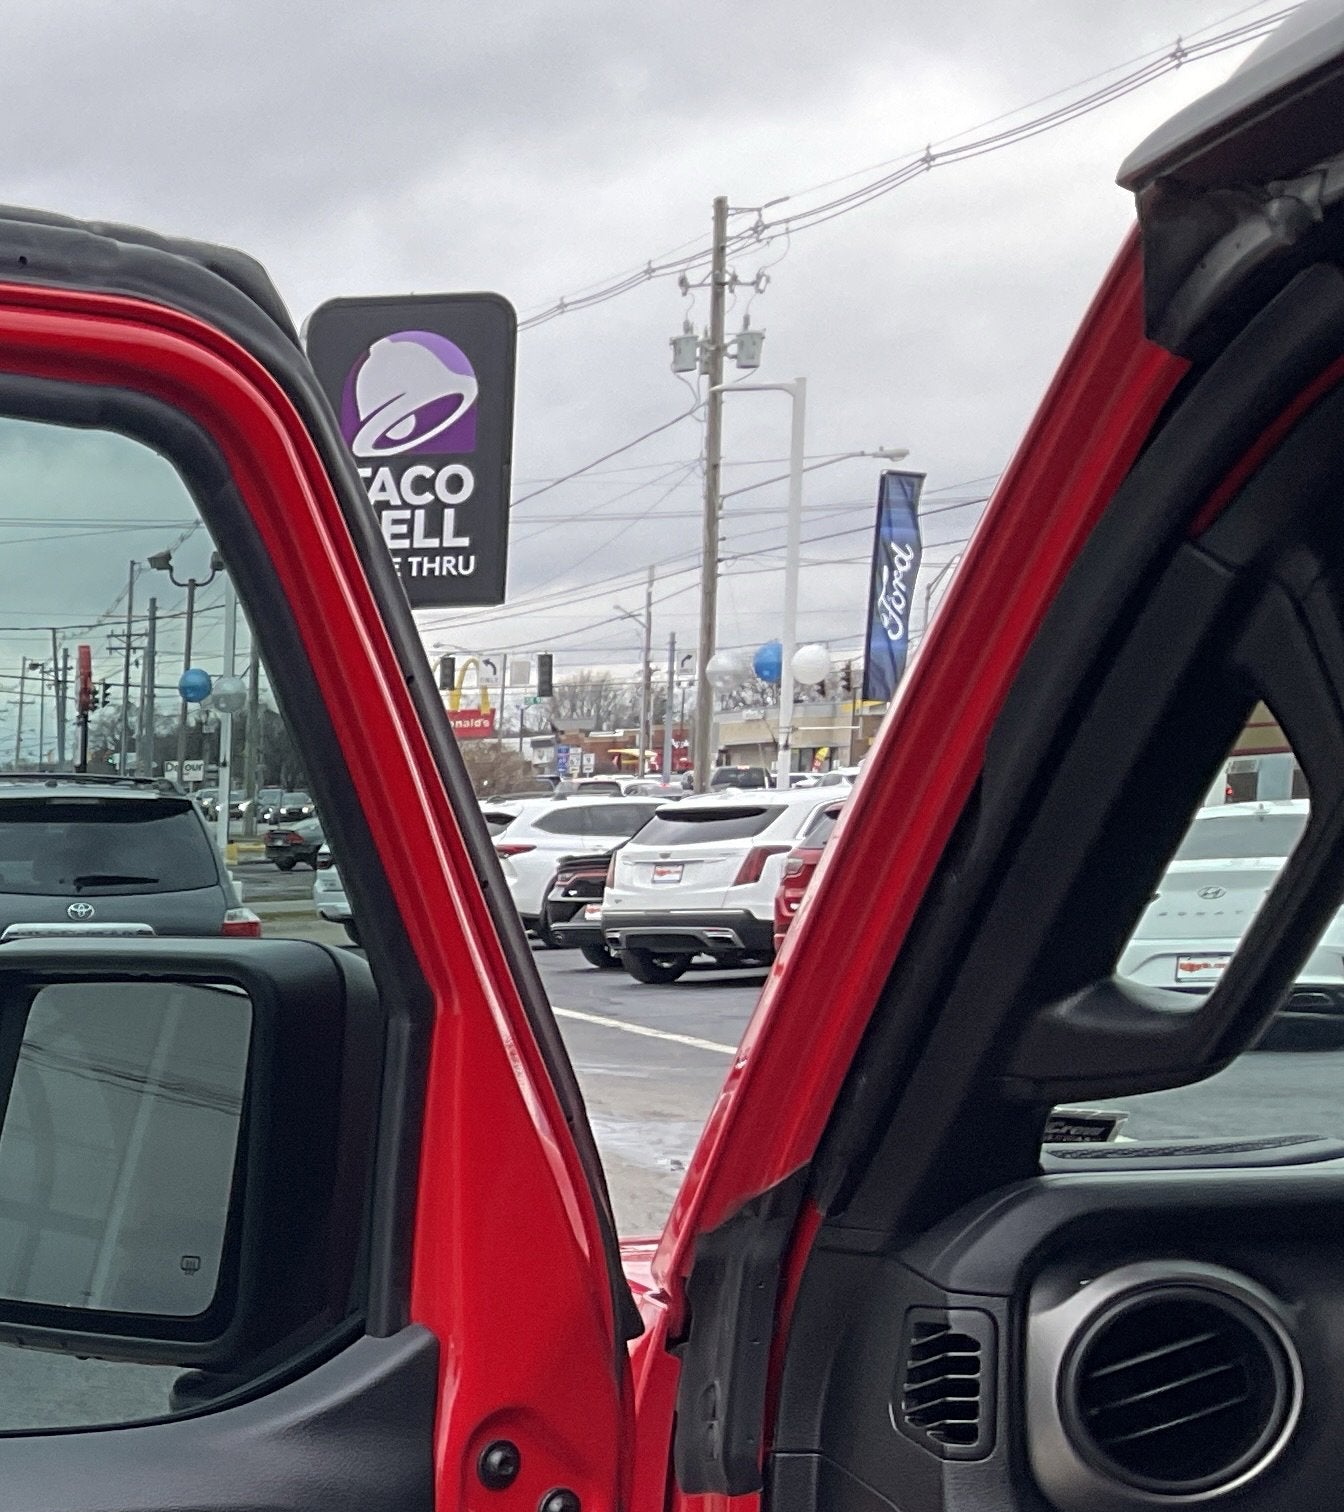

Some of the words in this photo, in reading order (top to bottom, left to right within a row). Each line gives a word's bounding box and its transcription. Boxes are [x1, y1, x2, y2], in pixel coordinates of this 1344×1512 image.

[381, 508, 470, 549] ELL
[407, 555, 476, 577] THRU
[877, 541, 915, 641] Ford
[450, 718, 490, 728] onald's
